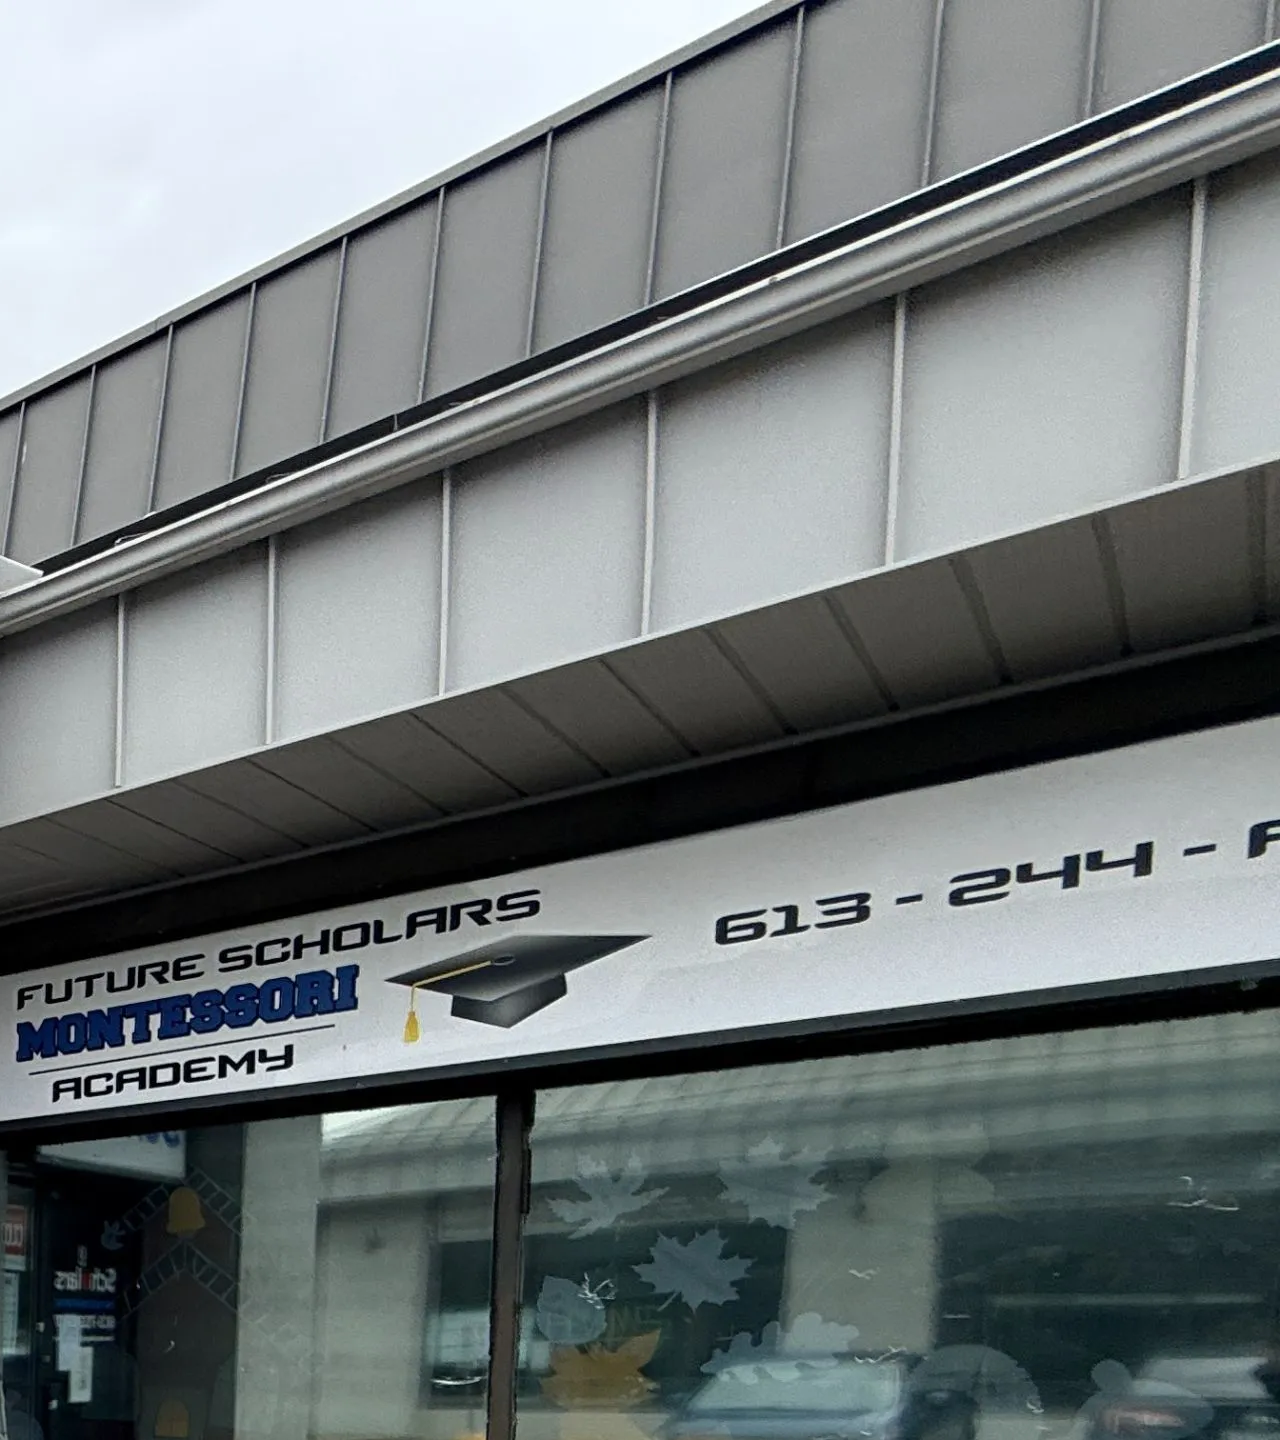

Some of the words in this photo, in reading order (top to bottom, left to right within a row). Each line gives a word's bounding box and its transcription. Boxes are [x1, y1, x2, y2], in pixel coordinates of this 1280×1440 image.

[714, 891, 871, 946] 613
[948, 841, 1154, 908] 244
[16, 953, 206, 1012] FUTURE
[218, 889, 541, 973] SCHOLARS
[15, 963, 361, 1063] MONTESSORI
[51, 1043, 294, 1103] ACADEMY
